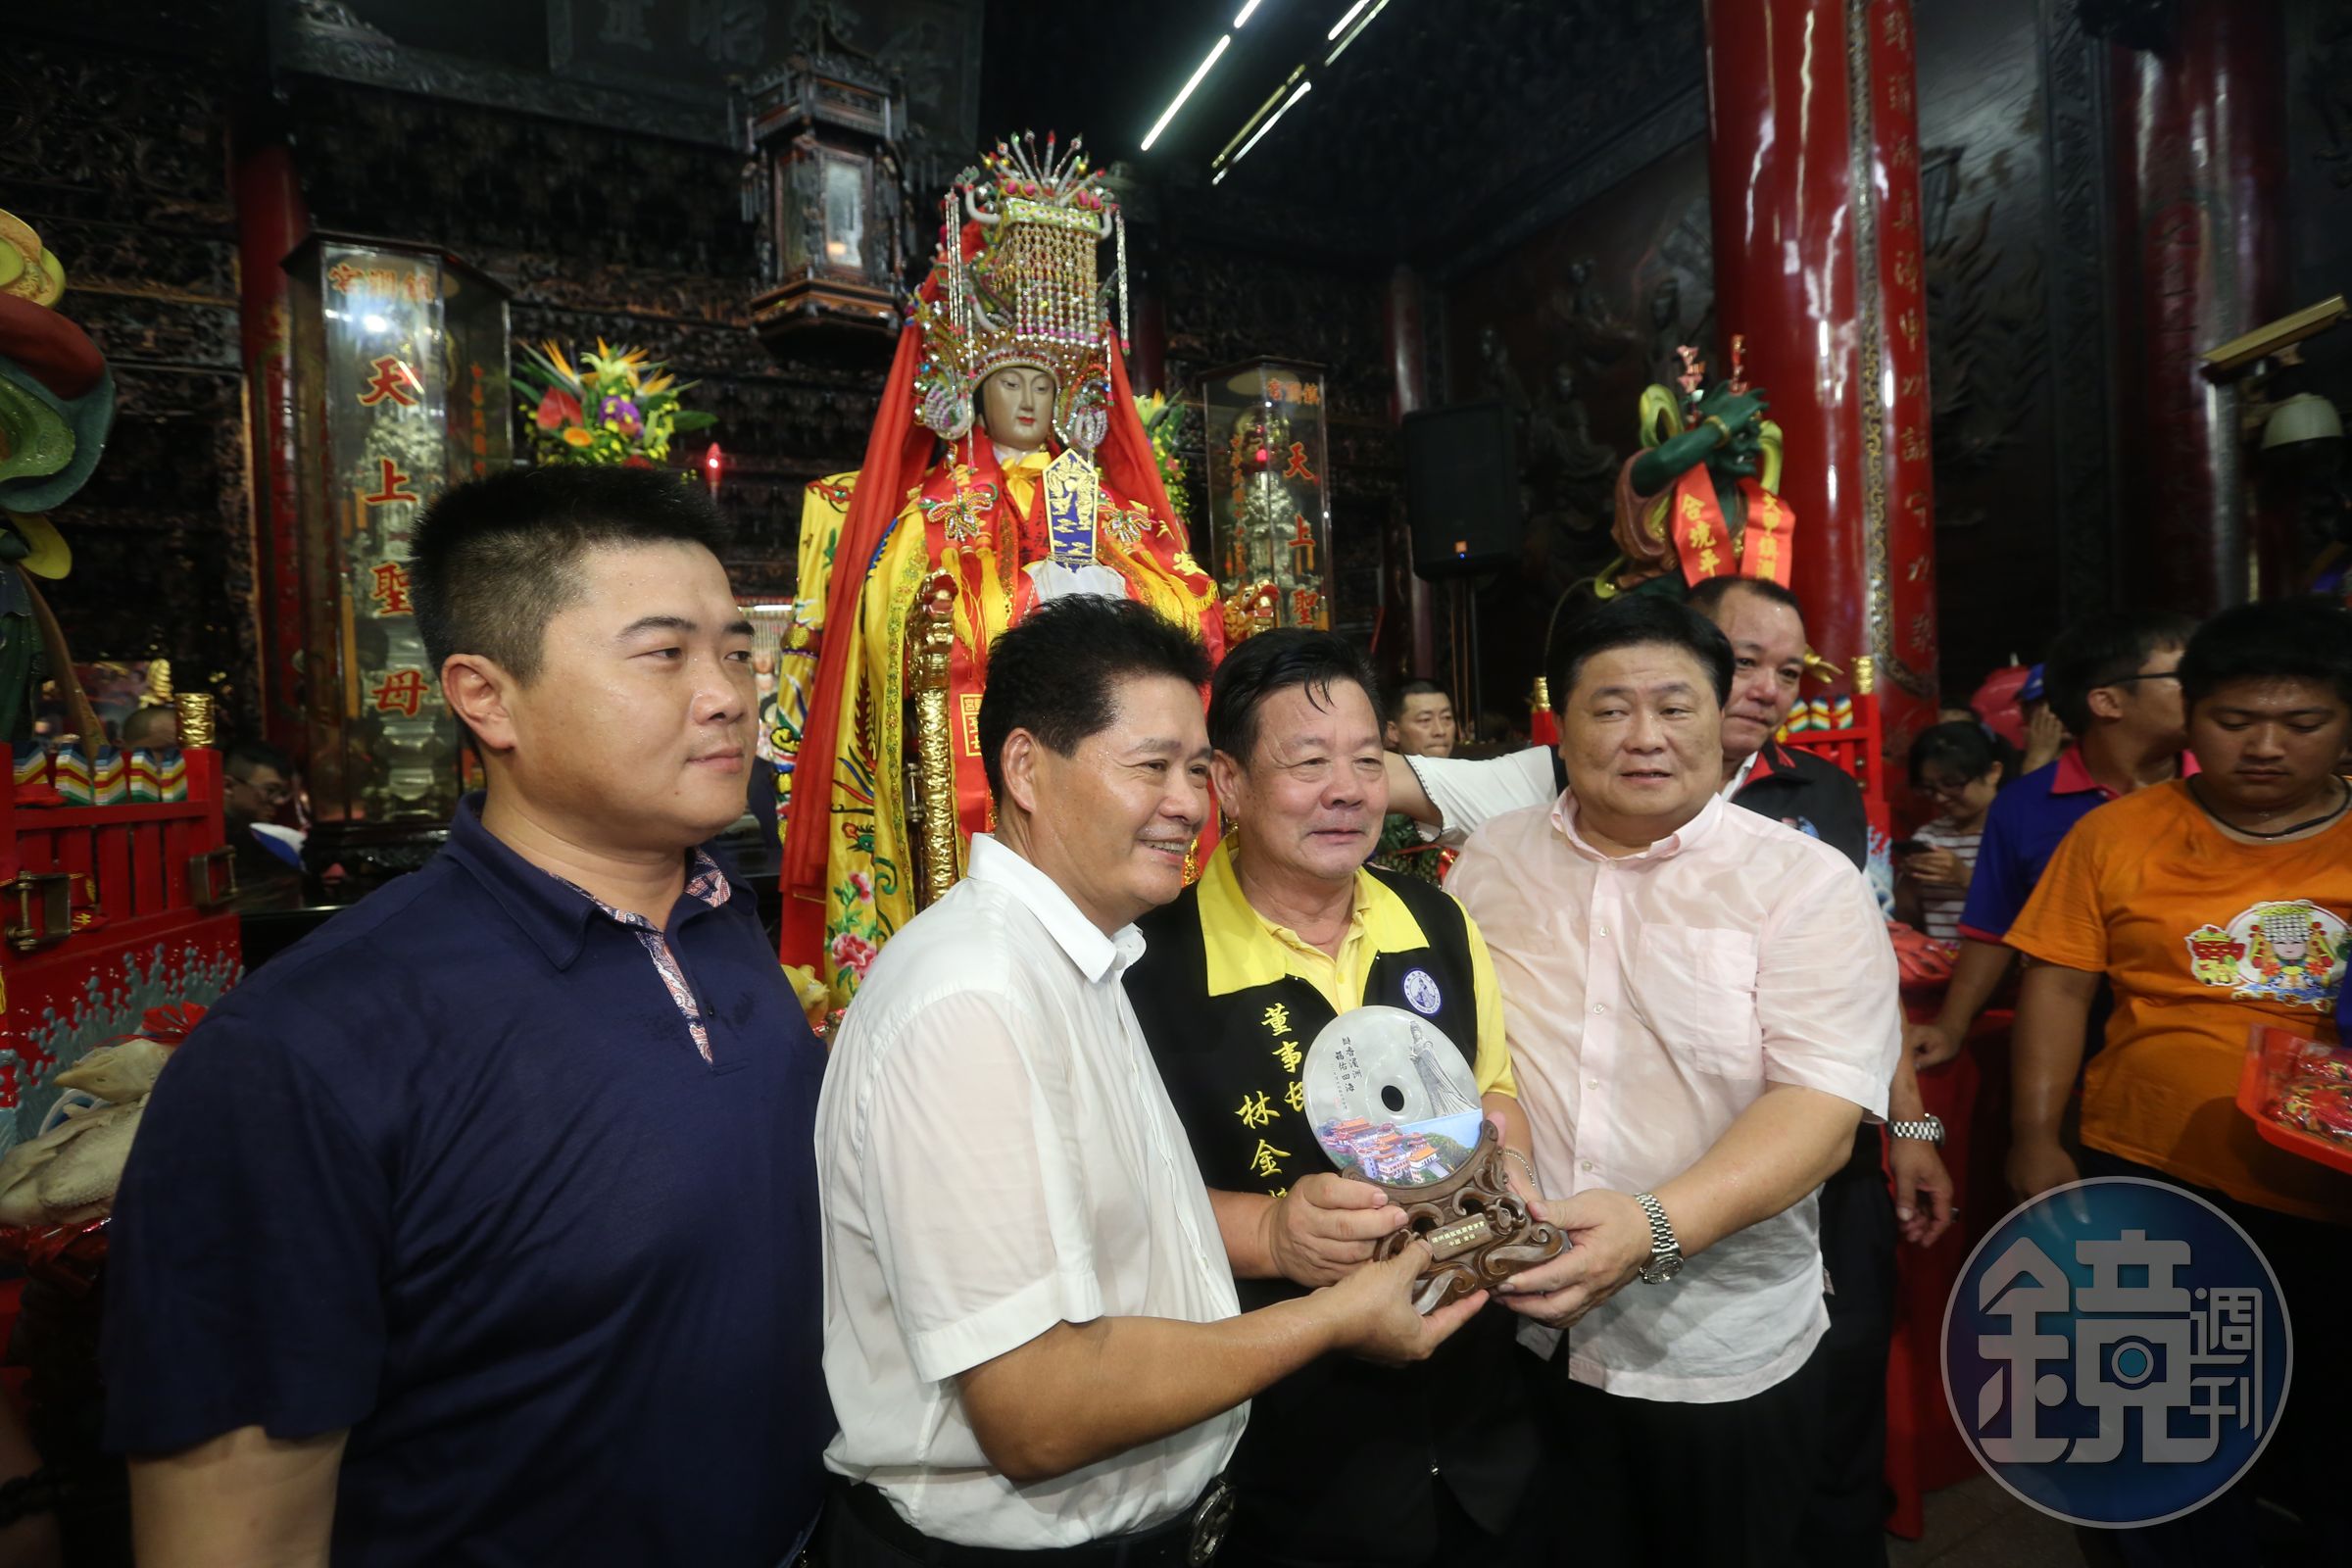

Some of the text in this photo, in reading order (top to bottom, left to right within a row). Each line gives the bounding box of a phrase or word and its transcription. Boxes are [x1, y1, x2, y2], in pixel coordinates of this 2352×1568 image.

[357, 356, 427, 717] 天上聖母
[1285, 441, 1318, 625] 天上聖
[1682, 493, 1721, 577] 合境平
[1234, 1090, 1292, 1199] 林金
